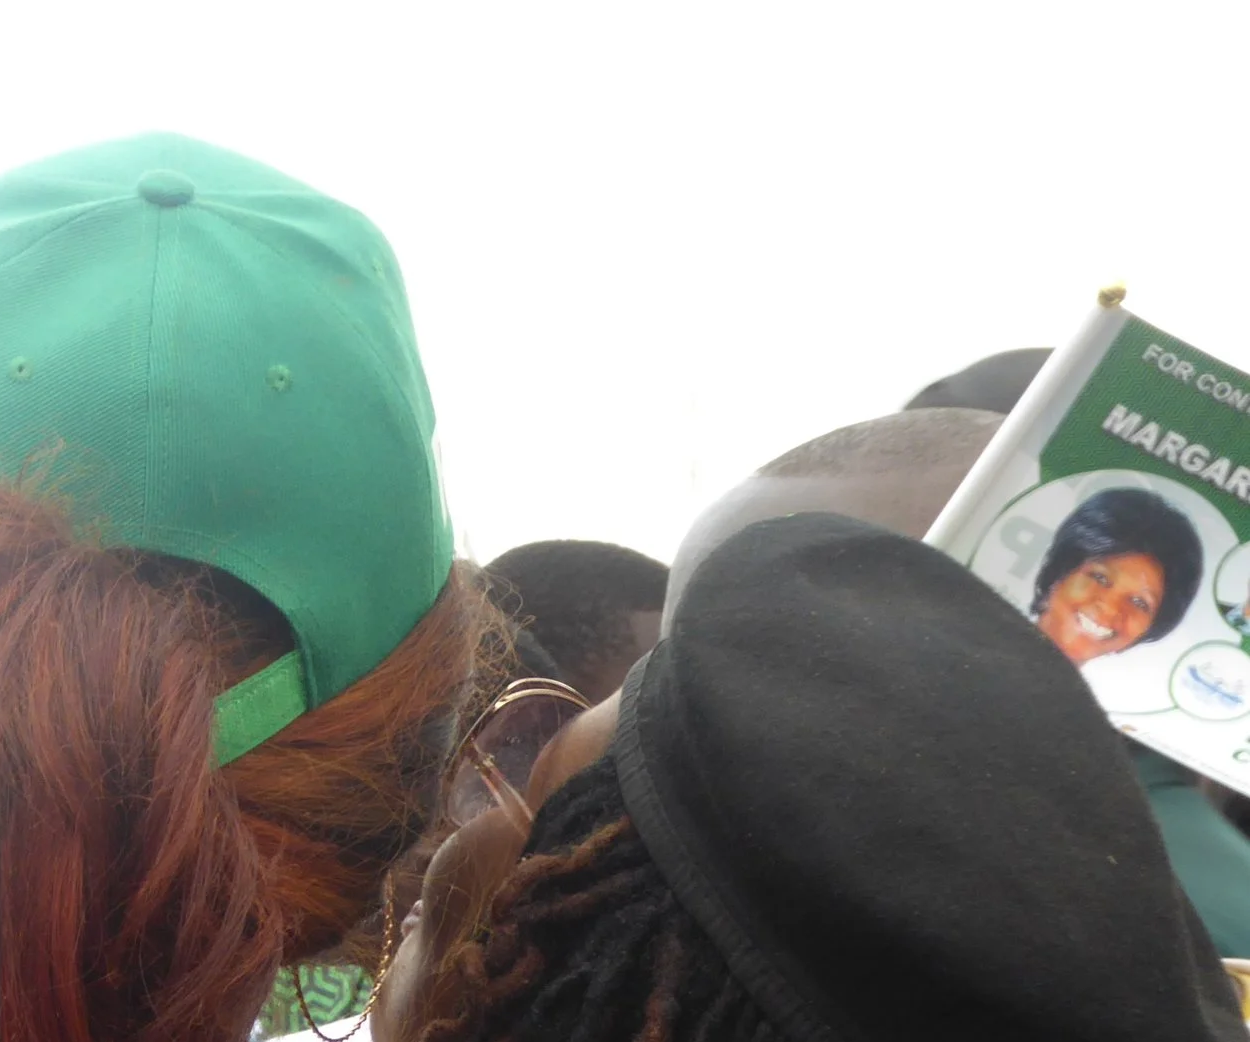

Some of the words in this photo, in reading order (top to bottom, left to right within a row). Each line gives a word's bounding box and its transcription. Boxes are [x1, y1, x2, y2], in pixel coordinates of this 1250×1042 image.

[1141, 343, 1195, 383] FOR
[1197, 373, 1250, 415] CON
[1102, 403, 1250, 504] MARGAR
